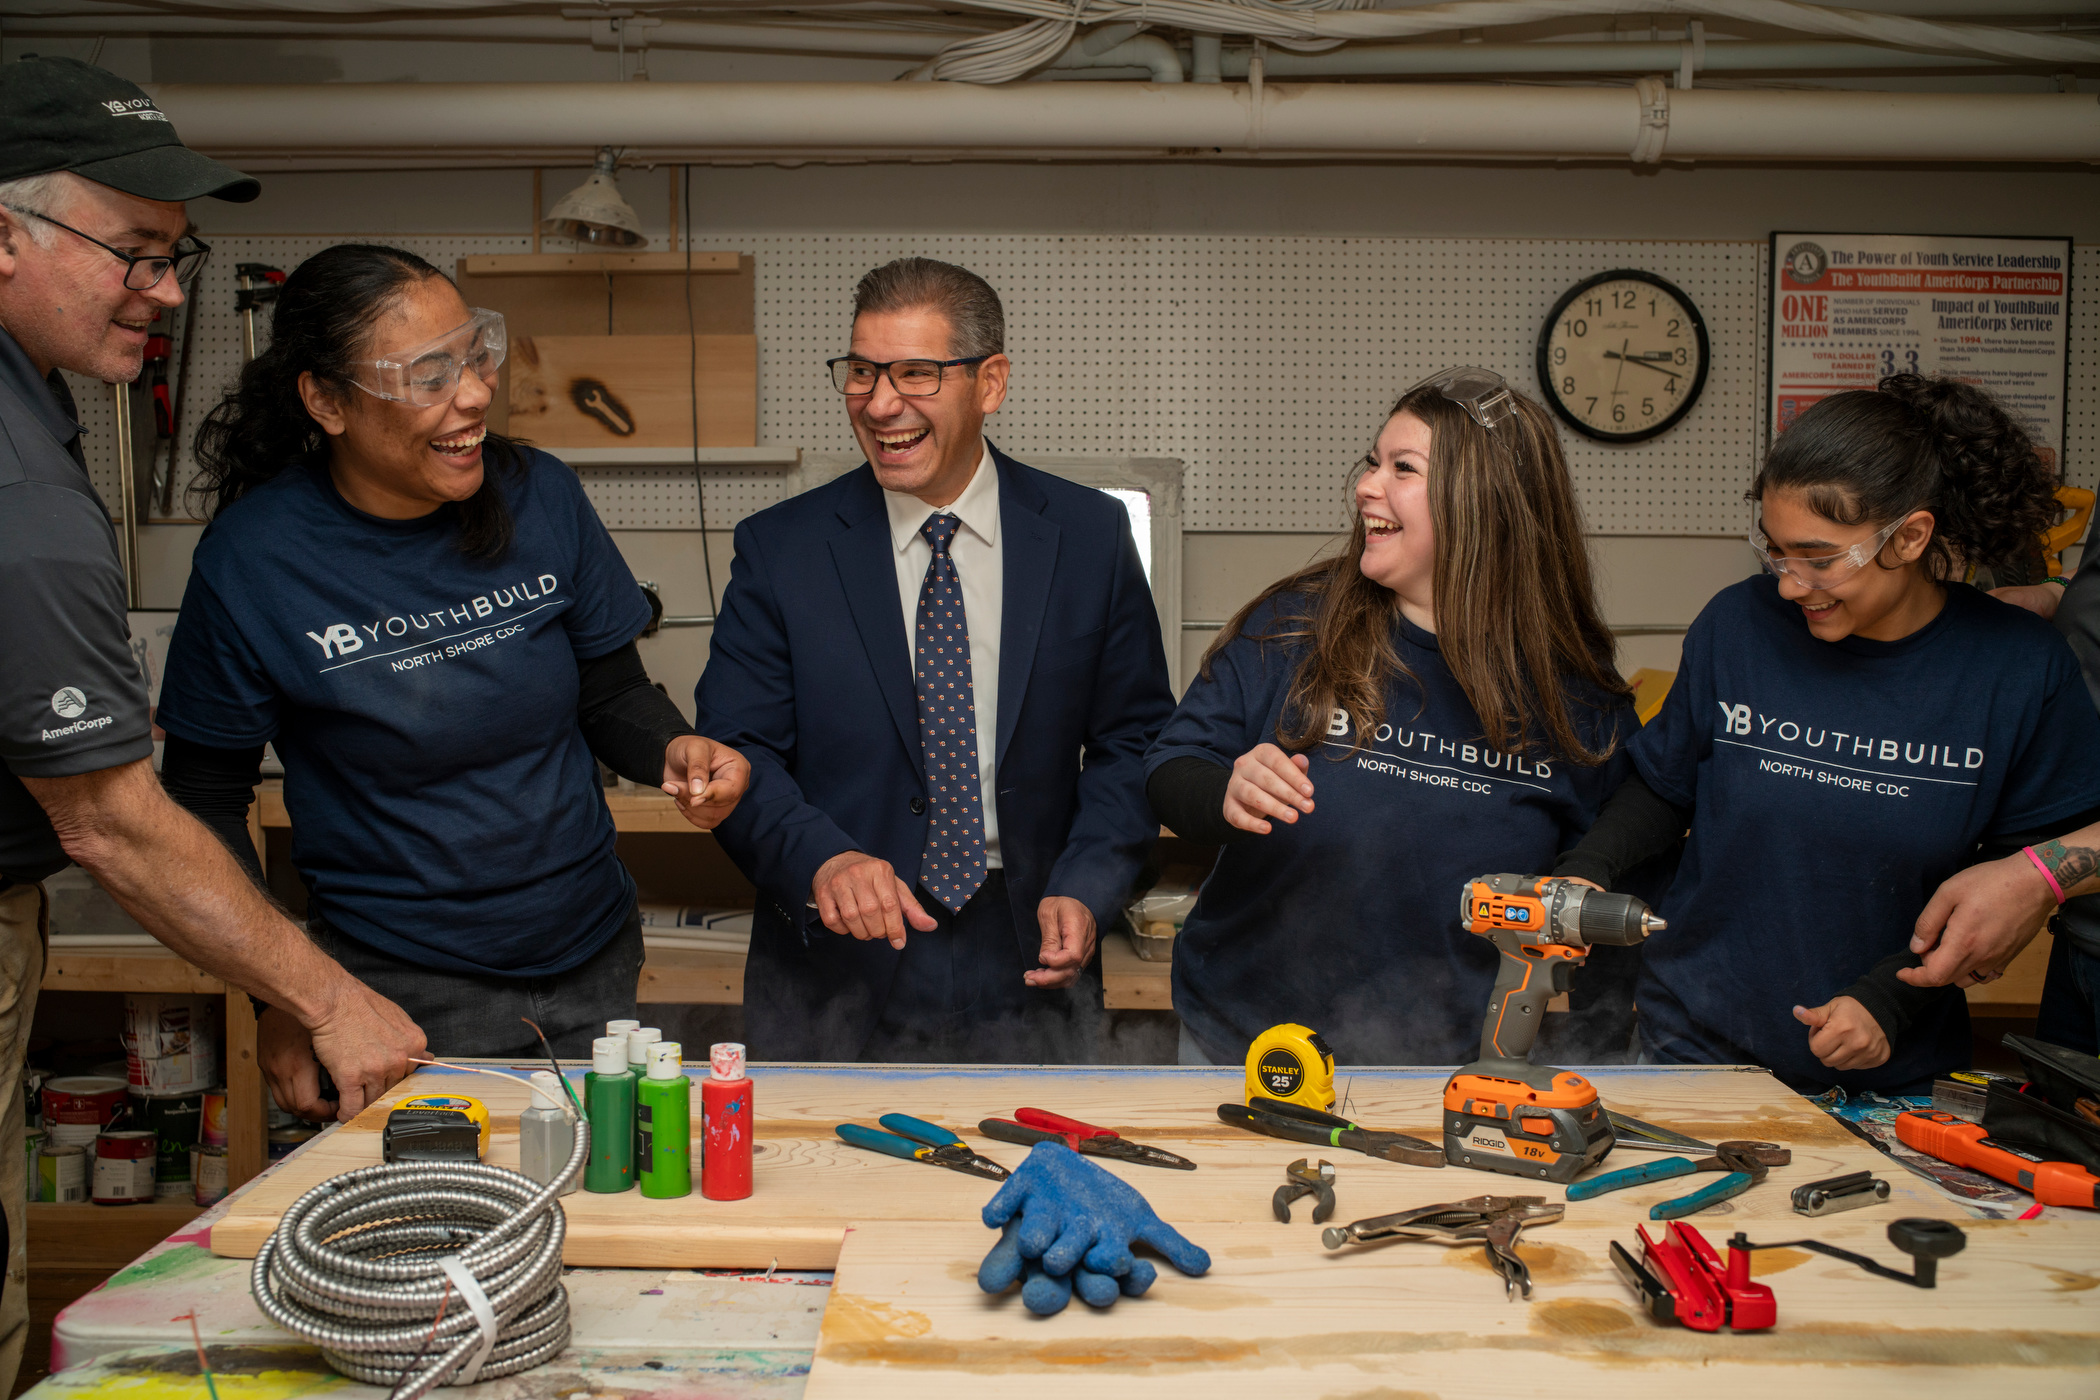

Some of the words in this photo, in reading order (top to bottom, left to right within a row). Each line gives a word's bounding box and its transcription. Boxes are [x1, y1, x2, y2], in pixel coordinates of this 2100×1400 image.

[101, 100, 127, 113] YB
[123, 98, 150, 109] YOU
[1799, 254, 1813, 270] A
[1831, 251, 1853, 265] The
[1858, 251, 1896, 265] Power
[1900, 252, 1912, 265] of
[1916, 252, 1948, 266] Youth
[1952, 253, 1994, 267] Service
[1997, 254, 2061, 270] Leadership
[1831, 272, 1853, 286] The
[1857, 273, 1921, 287] YouthBuild
[1924, 274, 1990, 290] AmeriCorps
[1993, 276, 2060, 292] Partnership
[1585, 299, 1602, 317] 11
[1611, 290, 1636, 309] 12
[1648, 299, 1656, 317] 1
[1781, 295, 1828, 322] ONE
[1876, 298, 1920, 306] INDIVIDUALS
[1931, 299, 1974, 314] Impact
[1978, 299, 1989, 313] of
[1994, 300, 2059, 315] YouthBuild
[1873, 307, 1908, 315] SERVED
[1563, 319, 1587, 338] 10
[1666, 319, 1680, 338] 2
[1847, 317, 1906, 325] AMERICORPS
[1938, 315, 2006, 332] AmeriCorps
[2011, 317, 2052, 331] Service
[1781, 324, 1828, 338] MILLION
[1833, 327, 1877, 335] MEMBERS
[1554, 347, 1566, 366] 9
[1674, 347, 1687, 366] 3
[1812, 352, 1837, 360] TOTAL
[2017, 348, 2056, 356] AmeriCorps
[1782, 371, 1834, 379] AMERICORPS
[1836, 372, 1876, 380] MEMBERS
[2009, 371, 2032, 379] logged
[1562, 376, 1575, 395] 8
[1664, 378, 1677, 395] 4
[1585, 397, 1598, 415] 7
[1641, 397, 1654, 416] 5
[2013, 393, 2047, 402] developed
[2019, 402, 2046, 410] housing
[1613, 404, 1625, 422] 6
[306, 623, 364, 660] YB
[362, 573, 559, 643] YOUTHBUILD
[391, 649, 445, 673] NORTH
[446, 633, 496, 658] SHORE
[496, 623, 526, 640] CDC
[42, 715, 113, 741] AmeriCorps
[1718, 701, 1751, 736] YB
[1759, 713, 1984, 769] YOUTHBUILD
[1326, 707, 1349, 736] B
[1363, 721, 1552, 779] OUTHBUILD
[1357, 757, 1407, 779] NORTH
[1409, 770, 1459, 789] SHORE
[1462, 780, 1491, 795] CDC
[1759, 758, 1812, 780] NORTH
[1816, 771, 1872, 793] SHORE
[1875, 782, 1910, 798] CDC
[1262, 1065, 1299, 1075] STANLEY
[1271, 1075, 1293, 1088] 25'
[406, 1109, 455, 1117] LeverLock
[1472, 1136, 1505, 1149] RIDGID
